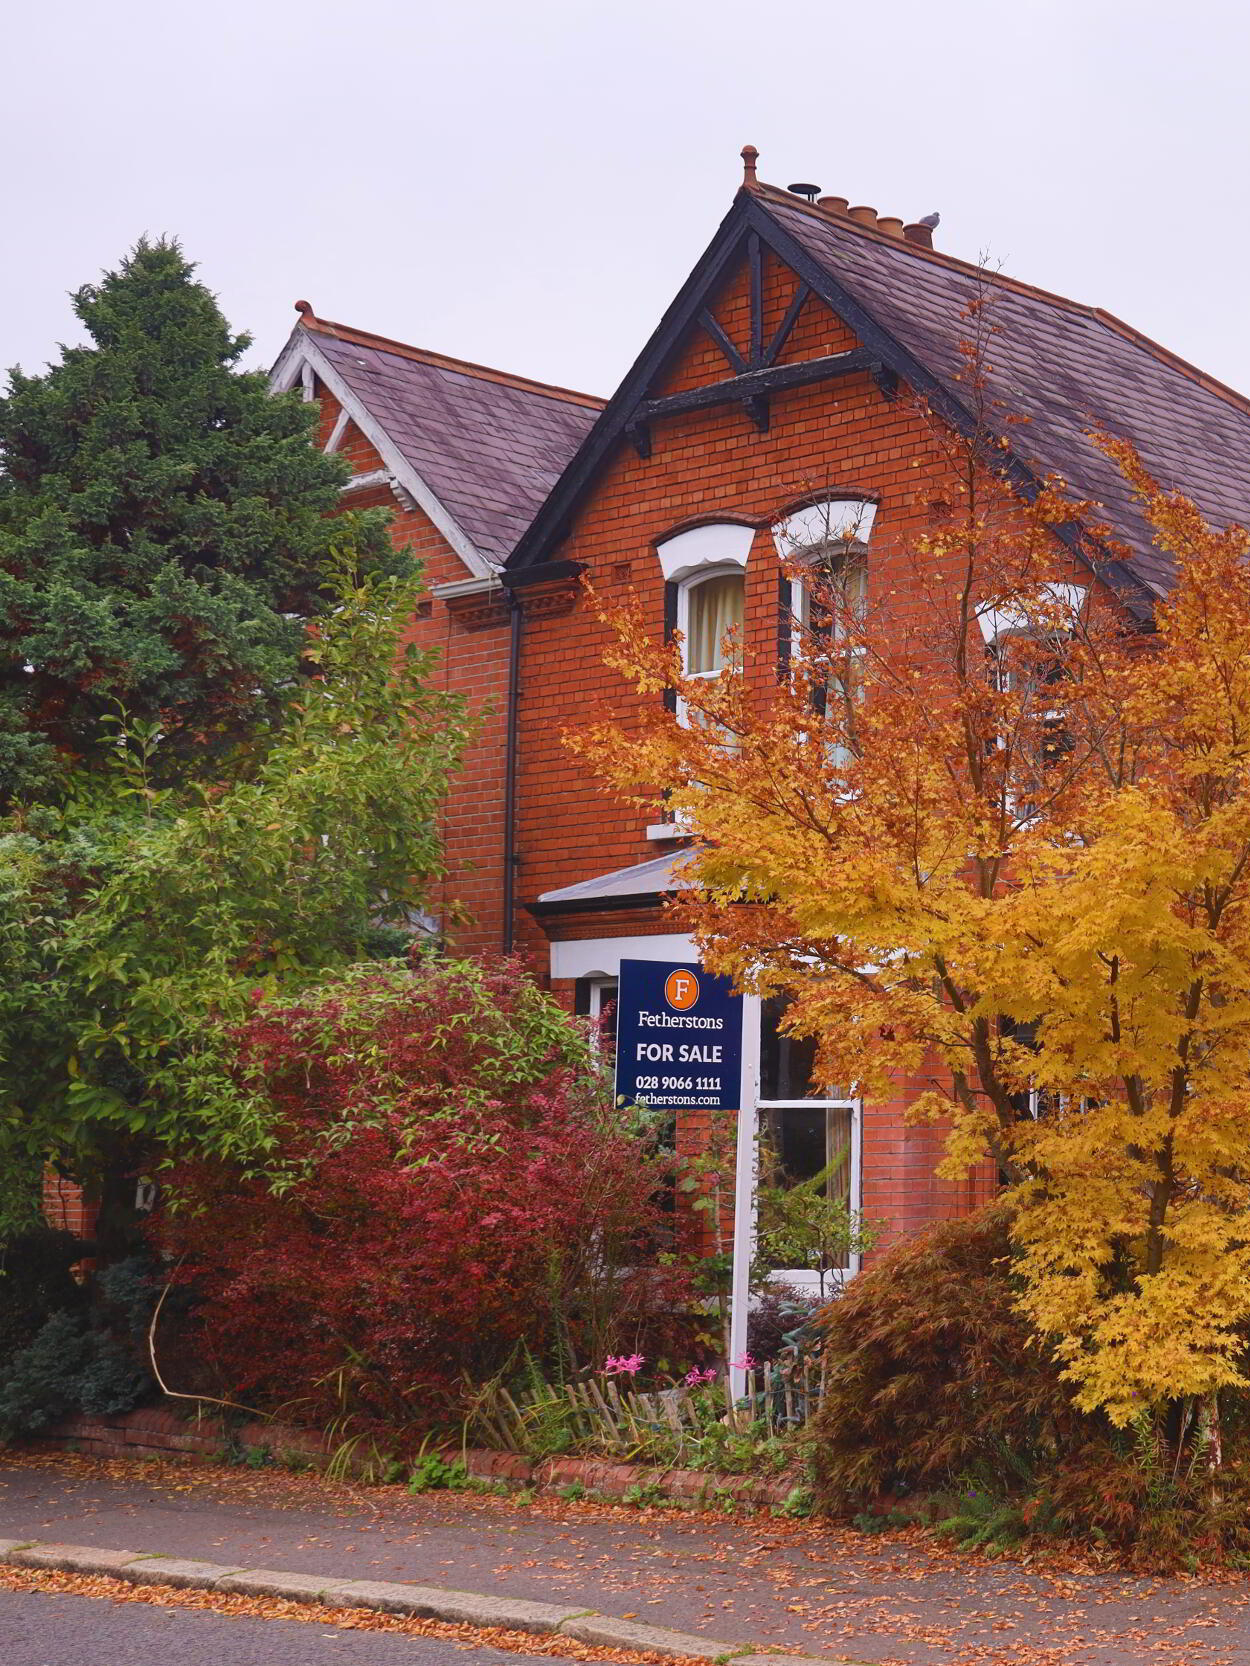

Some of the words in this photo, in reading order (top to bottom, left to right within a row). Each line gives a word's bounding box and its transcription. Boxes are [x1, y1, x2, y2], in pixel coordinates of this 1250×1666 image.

[675, 979, 690, 1001] F
[638, 1011, 723, 1030] Fetherstons
[636, 1043, 674, 1062] FOR
[678, 1044, 723, 1063] SALE
[635, 1075, 659, 1089] 028
[661, 1076, 693, 1090] 9066
[695, 1077, 722, 1090] 1111
